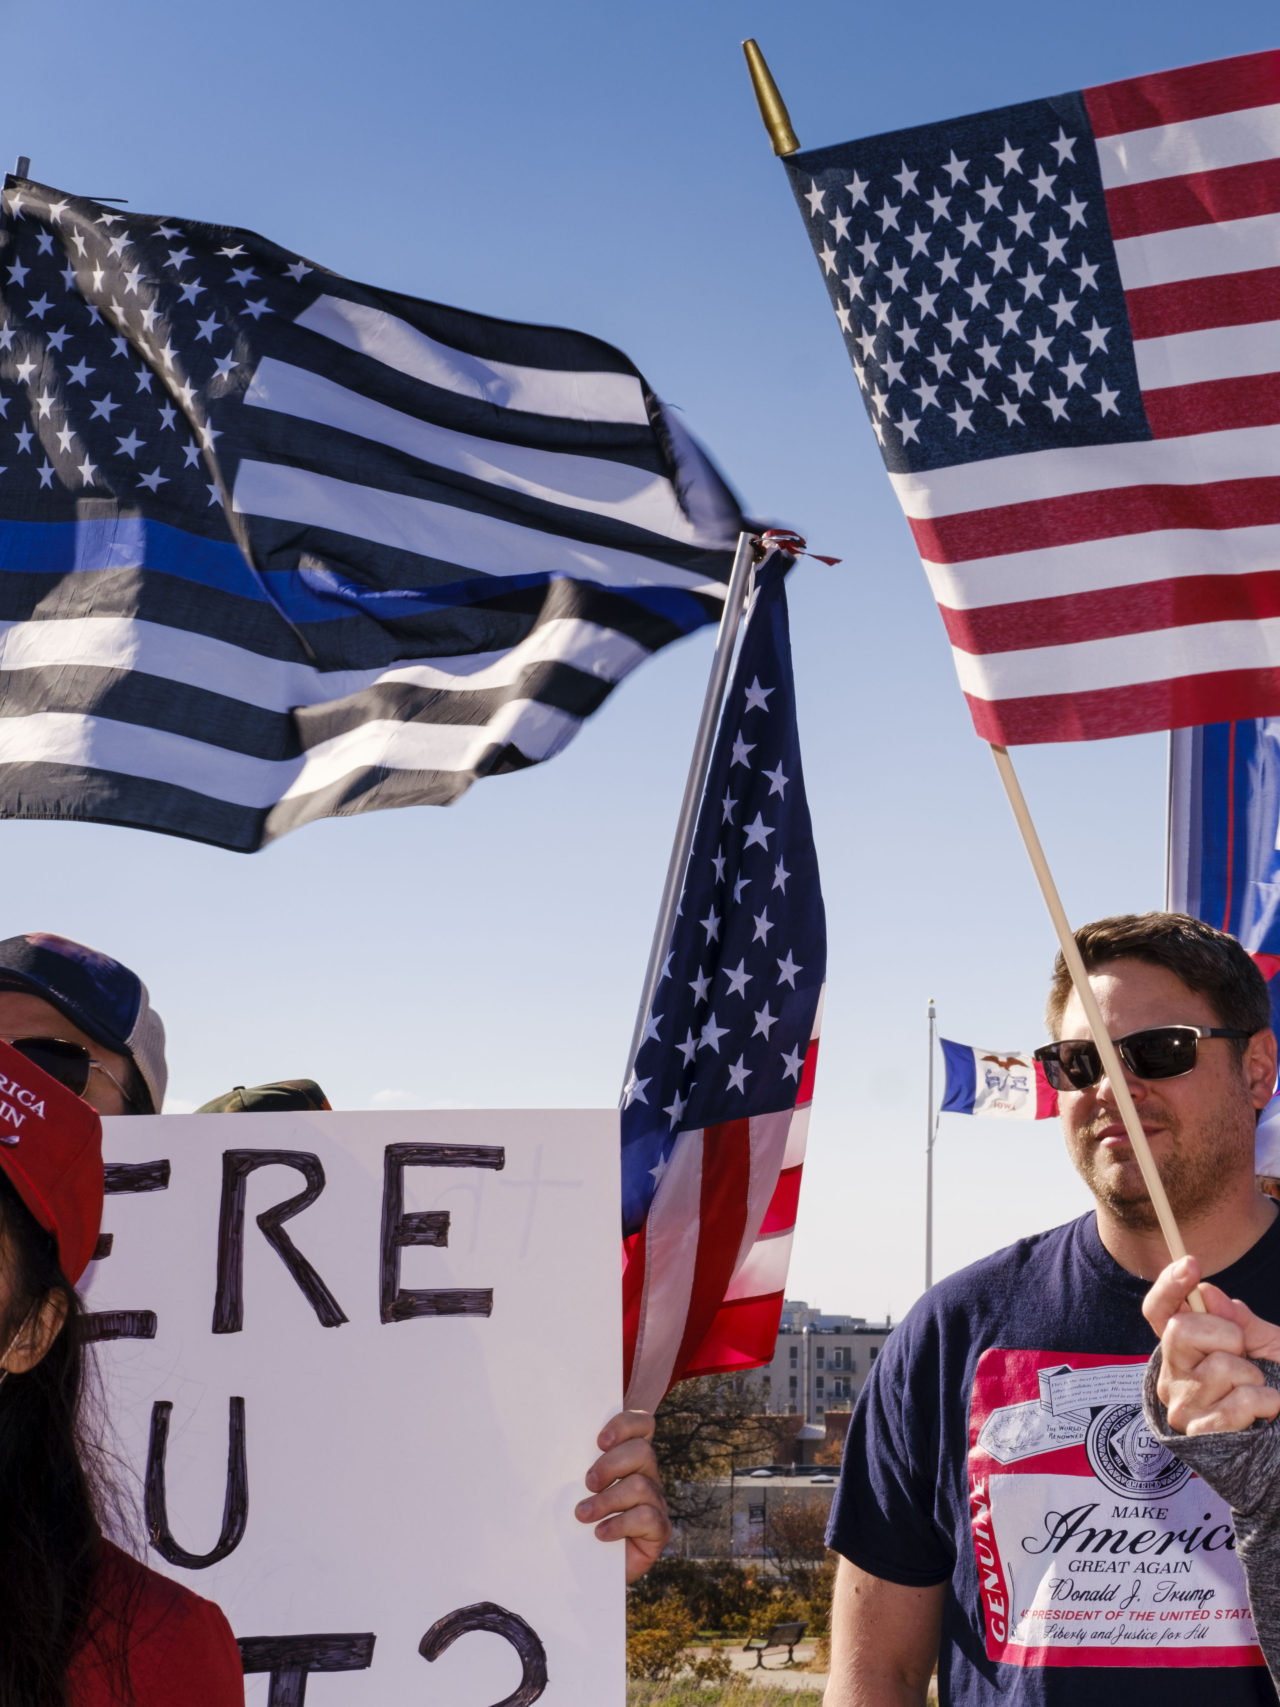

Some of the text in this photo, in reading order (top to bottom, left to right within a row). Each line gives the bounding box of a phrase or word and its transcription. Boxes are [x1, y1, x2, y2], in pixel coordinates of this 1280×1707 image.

[144, 1396, 249, 1570] U
[1111, 1505, 1169, 1520] MAKE
[972, 1474, 1007, 1643] GENUINE
[1068, 1559, 1194, 1574] GREAT AGAIN
[1048, 1578, 1216, 1610] Donald J. Trump
[1032, 1608, 1102, 1621] PRESIDENT
[1104, 1610, 1126, 1621] OF
[1128, 1610, 1156, 1621] THE
[1159, 1609, 1211, 1621] UNITED
[1043, 1623, 1210, 1646] Liberty and Justice for All
